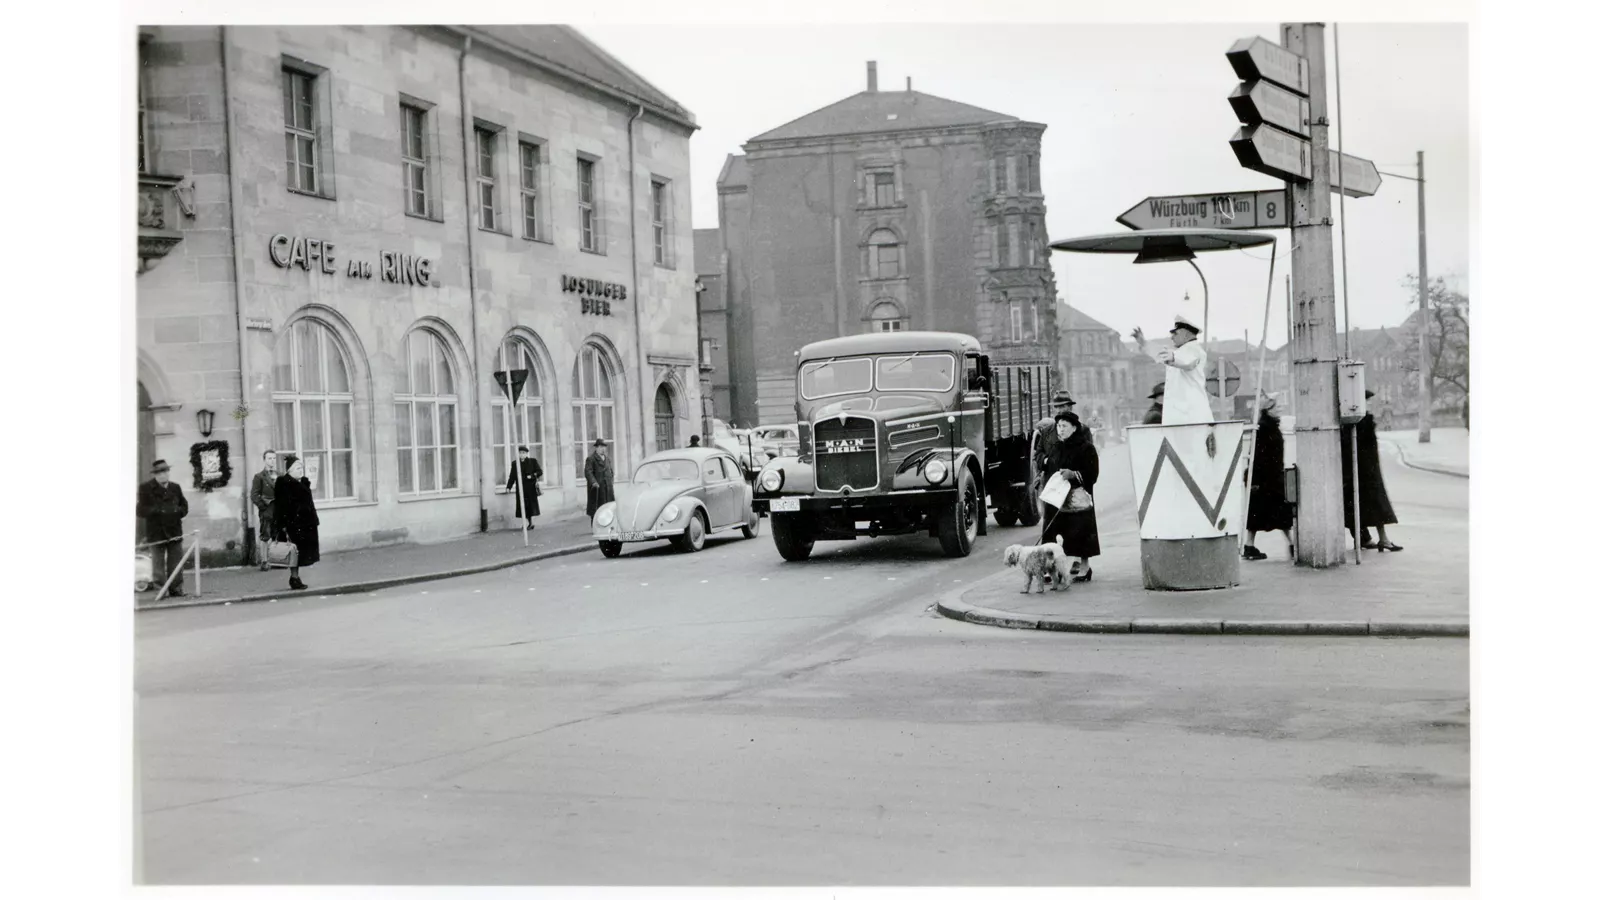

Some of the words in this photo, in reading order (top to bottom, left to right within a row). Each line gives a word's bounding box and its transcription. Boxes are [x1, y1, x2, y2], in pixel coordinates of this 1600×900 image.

[1149, 198, 1208, 219] Würzburg
[1234, 197, 1250, 213] km
[1266, 201, 1277, 219] 8
[1170, 218, 1198, 228] Fürth
[1212, 216, 1218, 225] 7
[1220, 216, 1232, 225] km
[269, 234, 336, 275] CAFE
[380, 250, 430, 287] RING
[581, 297, 611, 317] BIER
